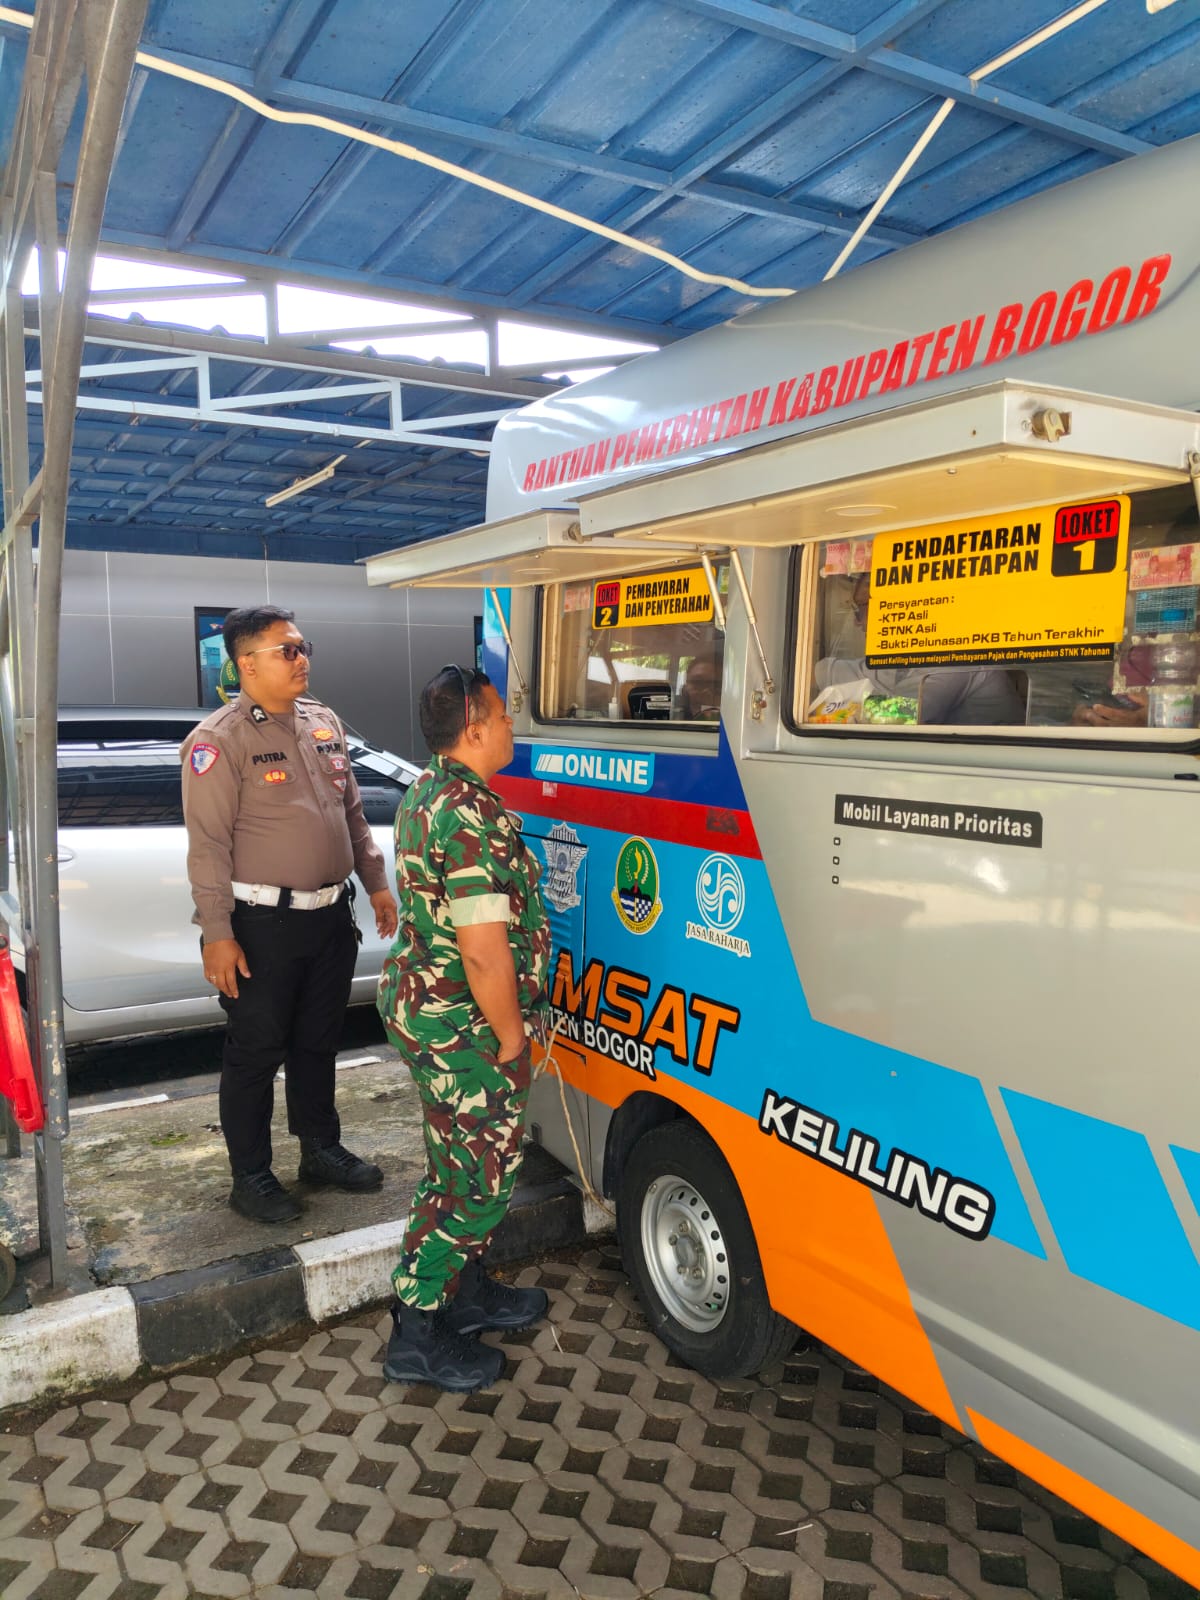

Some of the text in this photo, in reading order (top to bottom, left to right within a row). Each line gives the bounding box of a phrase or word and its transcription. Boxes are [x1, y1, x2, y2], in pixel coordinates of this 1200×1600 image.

[523, 253, 1172, 493] BANTUAN PEMERINTAH KABUPATEN BOGOR
[1061, 508, 1115, 538] LOKET
[892, 523, 1041, 562] PENDAFTARAN
[1073, 540, 1096, 571] 1
[875, 550, 1039, 588] DAN PENETAPAN
[598, 586, 618, 603] LOKET
[626, 577, 690, 600] PEMBAYARAN
[600, 607, 612, 626] 2
[625, 594, 711, 618] DAN PENYERAHAN
[878, 610, 929, 623] -KTP Asli
[876, 626, 1105, 650] -Bukti Pelunasan PKB Tahun Terakhir
[877, 623, 937, 637] -STNK Asli
[951, 653, 987, 663] Pembayaran
[988, 652, 1005, 661] Pajak
[1005, 651, 1018, 660] dan
[1018, 650, 1059, 660] Pengesahan
[1059, 648, 1079, 657] STNK
[1080, 647, 1111, 657] Tahunan
[251, 751, 287, 766] PUTRA
[564, 753, 649, 785] ONLINE
[843, 802, 1032, 838] Mobil Layanan Prioritas
[686, 922, 751, 954] JASA RAHARJA
[545, 952, 740, 1071] MSAT
[583, 1020, 655, 1077] BOGOR
[760, 1093, 991, 1235] KELILING
